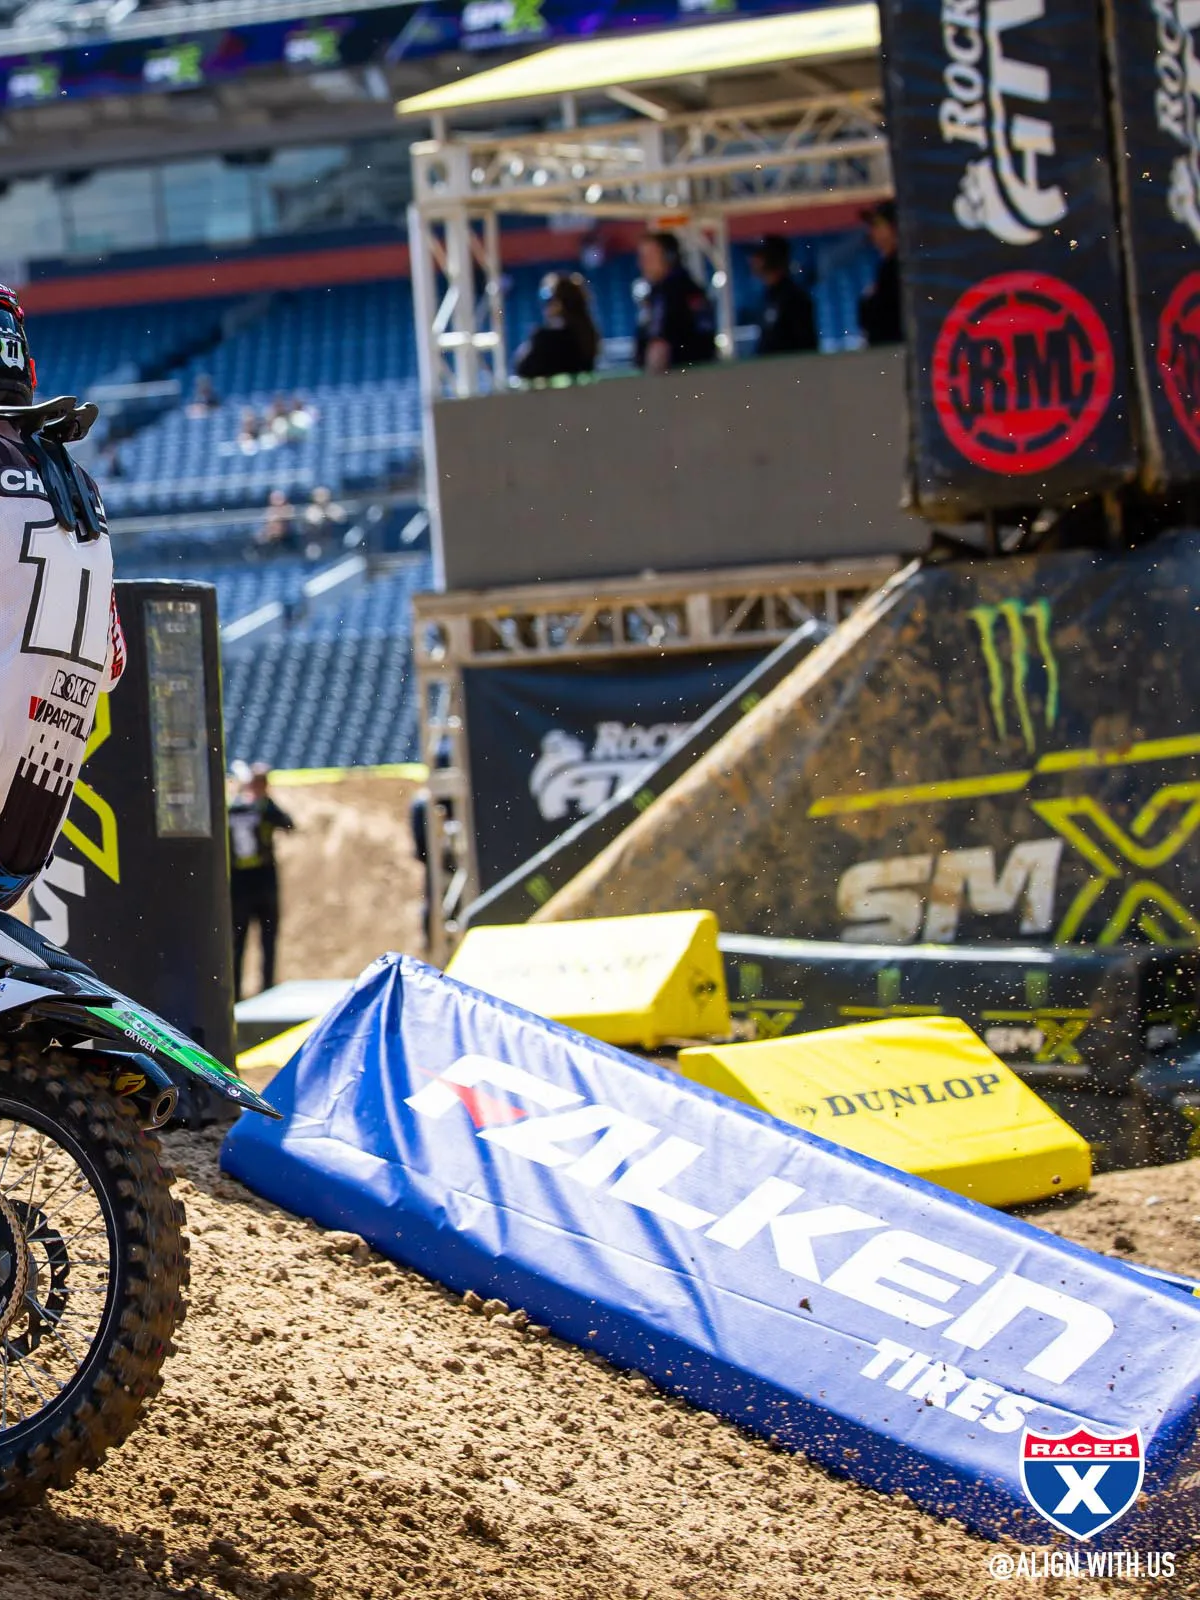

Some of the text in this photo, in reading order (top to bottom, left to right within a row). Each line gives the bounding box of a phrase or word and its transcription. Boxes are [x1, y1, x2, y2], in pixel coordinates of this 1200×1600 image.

[6, 340, 19, 359] 11
[124, 1028, 158, 1053] OXYGEN
[824, 1072, 1002, 1119] DUNLOP
[860, 1338, 1031, 1434] TIRES
